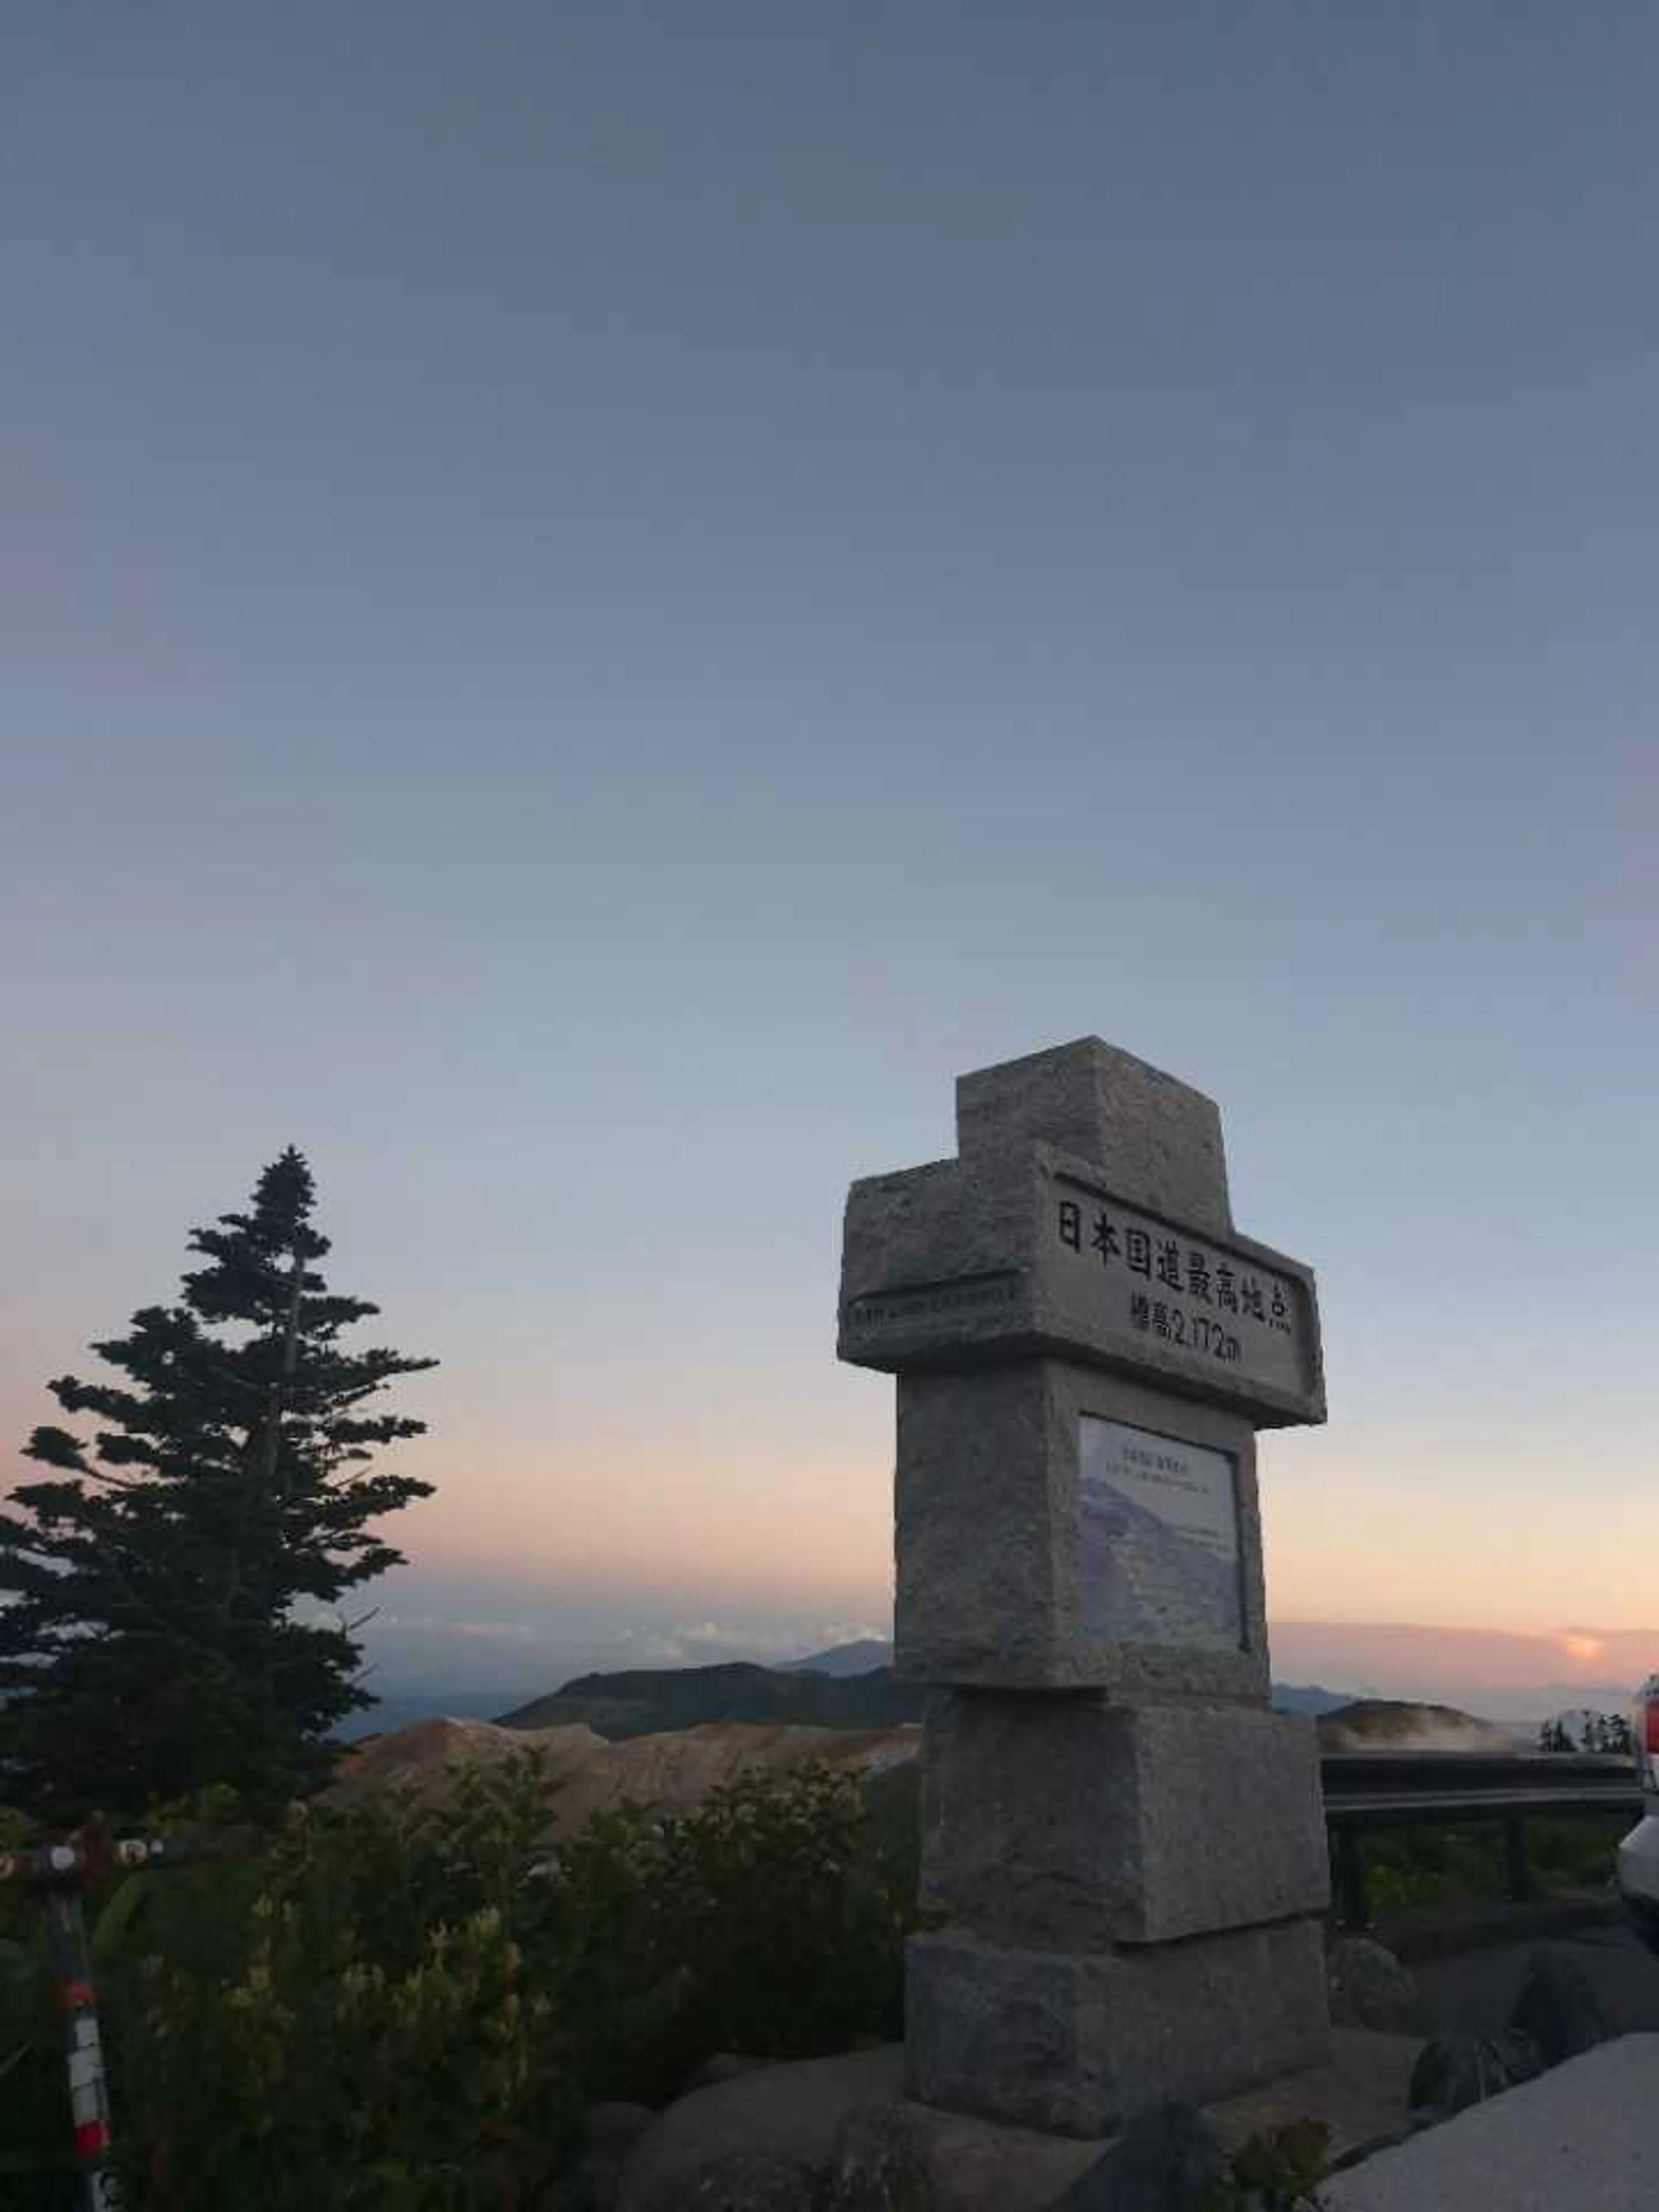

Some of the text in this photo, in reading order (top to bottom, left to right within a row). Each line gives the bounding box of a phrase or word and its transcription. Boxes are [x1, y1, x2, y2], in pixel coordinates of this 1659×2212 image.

[1059, 1200, 1291, 1335] 日本国道最高地点
